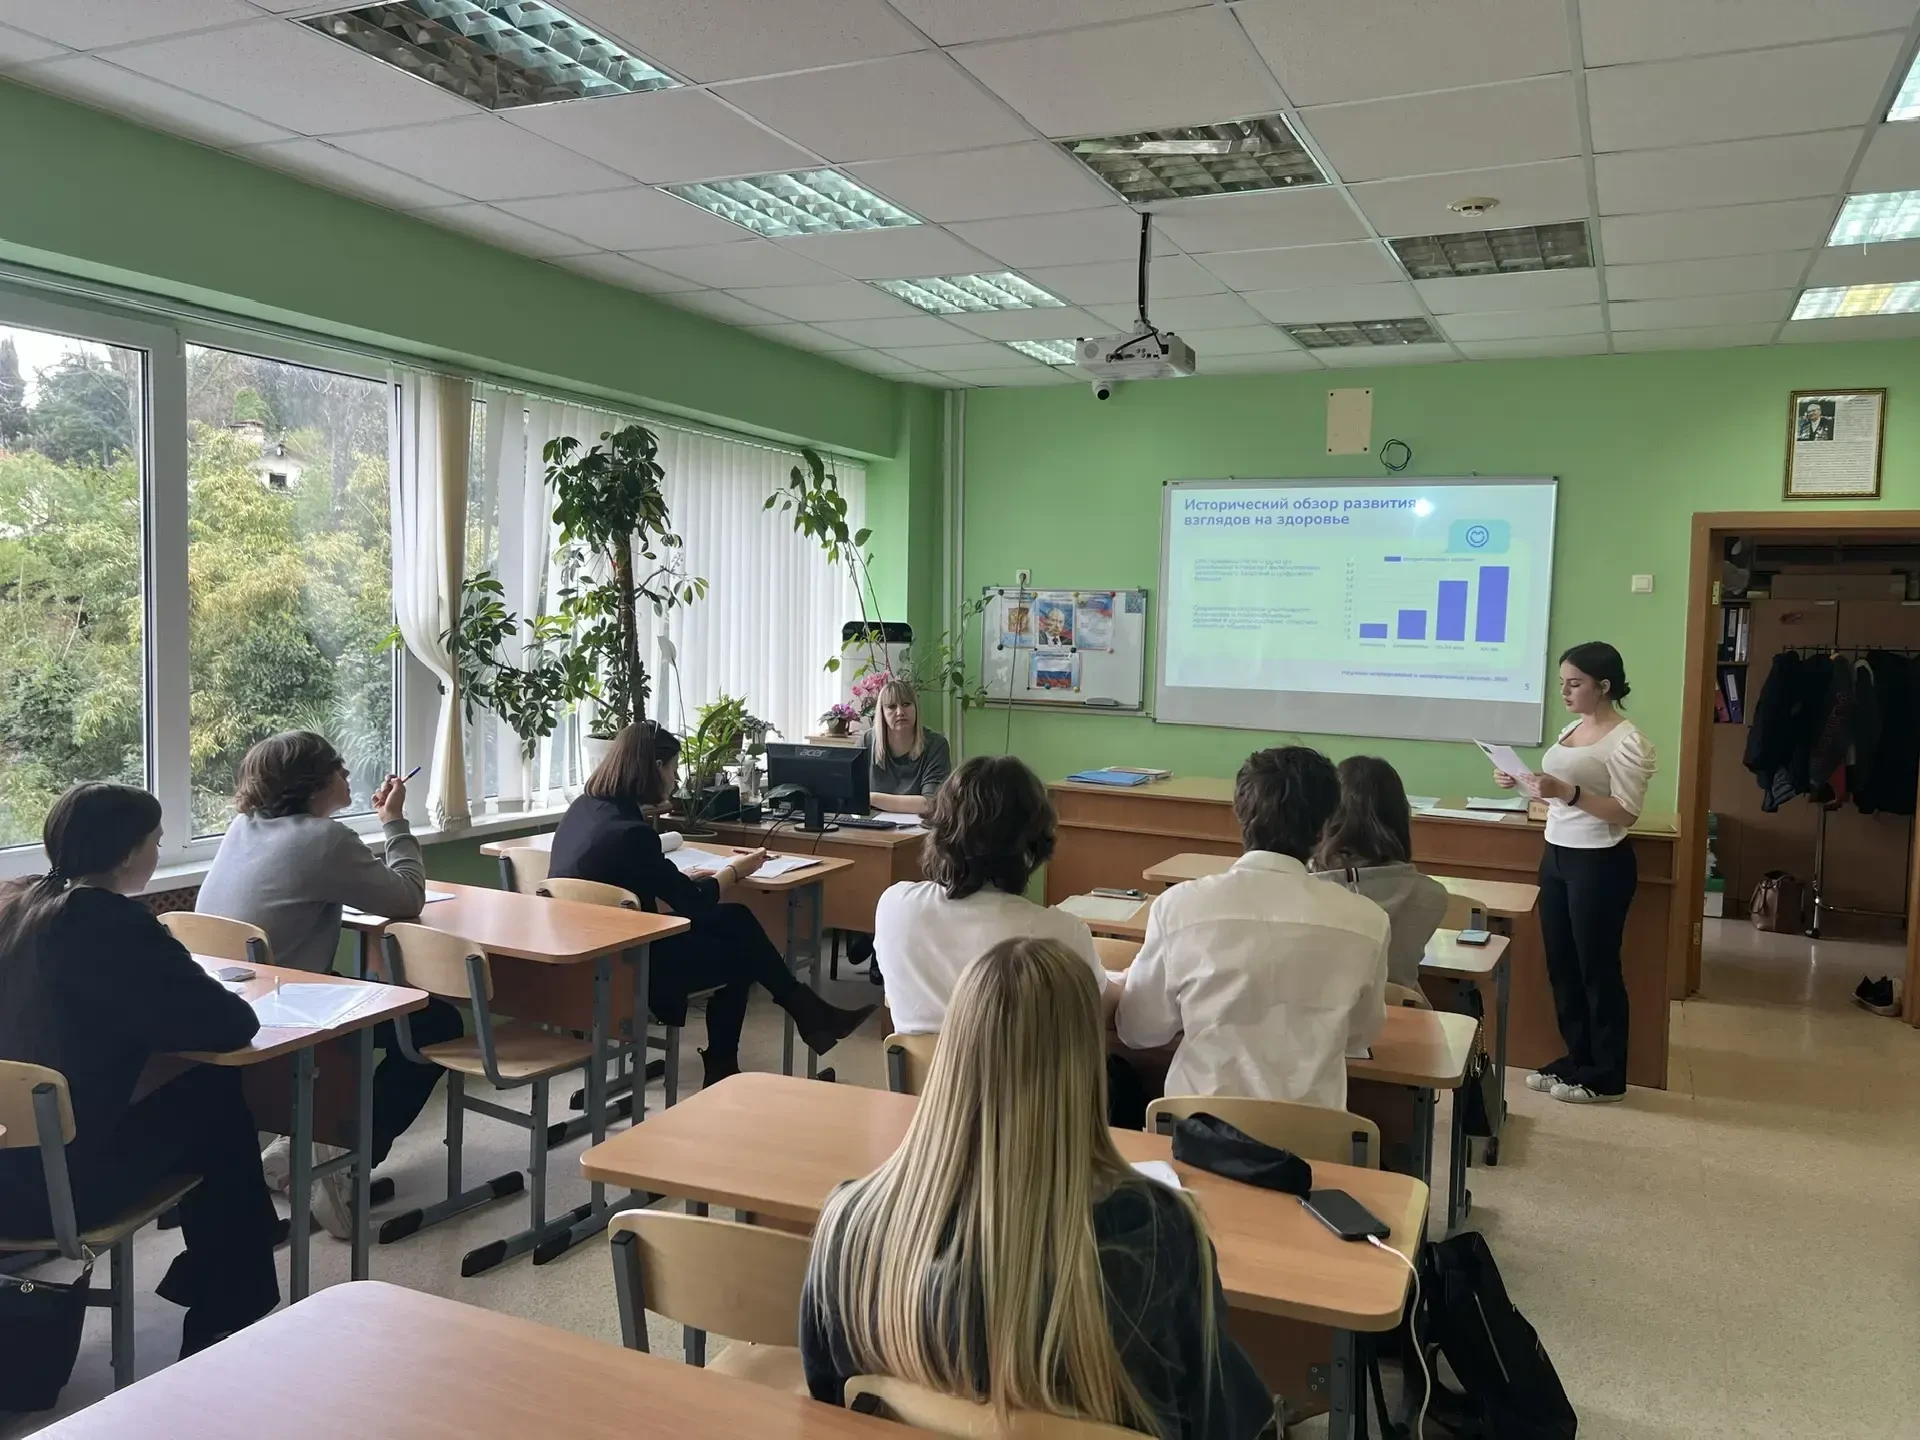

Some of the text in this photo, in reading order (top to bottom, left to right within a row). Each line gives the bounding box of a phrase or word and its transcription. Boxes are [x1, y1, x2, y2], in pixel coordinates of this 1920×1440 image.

[1184, 497, 1417, 513] Исторический обзор развития
[1184, 515, 1350, 527] взглядов на здоровье
[1524, 682, 1530, 691] 5
[799, 748, 827, 758] acer
